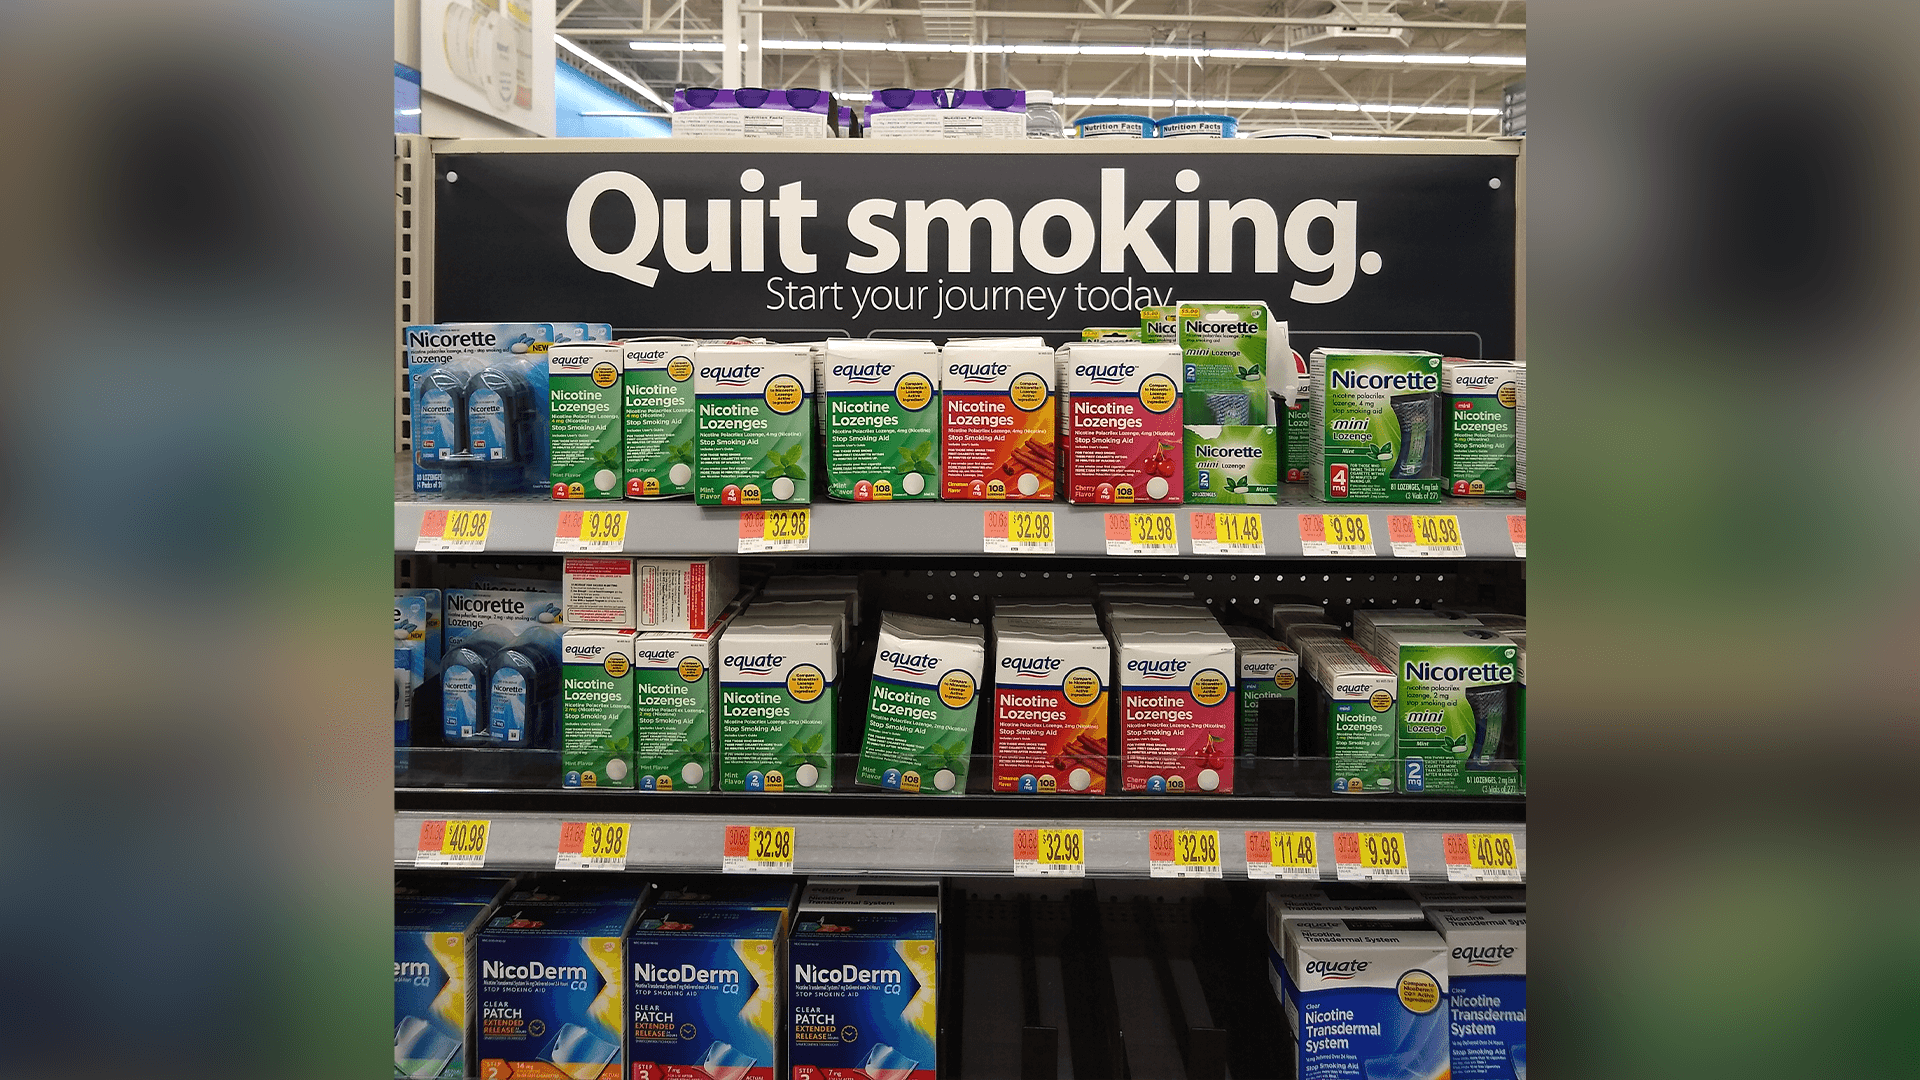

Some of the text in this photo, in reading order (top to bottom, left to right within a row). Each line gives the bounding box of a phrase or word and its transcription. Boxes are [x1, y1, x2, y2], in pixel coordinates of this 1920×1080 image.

[1084, 123, 1141, 133] Nutrition Facts
[1163, 123, 1221, 133] Nutrition Facts
[566, 167, 1383, 304] Quit smoking.
[767, 277, 843, 311] Start
[850, 285, 929, 319] your
[932, 279, 1068, 319] journey
[1187, 321, 1258, 333] Nicorette
[410, 331, 496, 348] Nicorette
[532, 344, 549, 352] NEW
[1186, 348, 1210, 356] mini
[411, 354, 453, 365] Lozenge
[552, 355, 589, 366] equate
[627, 350, 665, 361] equate
[700, 364, 761, 381] equate
[833, 363, 892, 380] equate
[949, 362, 1007, 379] equate
[1075, 363, 1135, 380] equate
[1187, 366, 1194, 376] 2
[1332, 370, 1437, 390] Nicorette
[1456, 375, 1495, 386] equate
[551, 390, 602, 400] Nicotine
[626, 385, 677, 395] Nicotine
[551, 401, 610, 413] Lozenges
[626, 395, 686, 407] Lozenges
[948, 401, 1006, 412] Nicotine
[700, 404, 759, 416] Nicotine
[832, 402, 889, 413] Nicotine
[1075, 402, 1134, 414] Nicotine
[1347, 408, 1371, 416] smoking
[832, 414, 899, 427] Lozenges
[948, 414, 1014, 427] Lozenges
[1454, 411, 1501, 420] Nicotine
[700, 418, 768, 430] Lozenges
[1075, 416, 1143, 428] Lozenges
[1333, 417, 1369, 430] mini
[1454, 422, 1508, 432] Lozenges
[964, 434, 995, 442] Smoking
[1333, 433, 1372, 442] Lozenge
[1196, 445, 1262, 458] Nicorette
[1196, 461, 1219, 469] mini
[1200, 473, 1208, 483] 2
[1332, 468, 1346, 484] 4
[1332, 484, 1346, 493] mg
[451, 513, 487, 537] $40.98
[588, 513, 621, 538] $9.98
[770, 512, 805, 537] $32.98
[1013, 514, 1050, 539] $32.98
[1134, 516, 1172, 540] $32.98
[1220, 516, 1259, 541] $11.48
[1330, 517, 1366, 542] $9.98
[1417, 518, 1457, 543] $40.98
[448, 595, 525, 613] Nicorette
[448, 617, 483, 629] Lozenge
[565, 645, 602, 656] equate
[638, 649, 676, 660] equate
[724, 653, 782, 670] equate
[880, 650, 938, 670] equate
[1001, 656, 1061, 674] equate
[1127, 658, 1187, 676] equate
[1244, 663, 1274, 673] equate
[1406, 661, 1512, 682] Nicorette
[493, 685, 523, 694] Nicorette
[564, 679, 614, 690] Nicotine
[638, 684, 688, 695] Nicotine
[1337, 683, 1370, 694] equate
[564, 690, 622, 702] Lozenges
[638, 695, 696, 707] Lozenges
[723, 692, 781, 704] Nicotine
[874, 686, 931, 705] Nicotine
[1000, 695, 1058, 707] Nicotine
[1126, 696, 1184, 708] Nicotine
[723, 706, 790, 718] Lozenges
[872, 700, 937, 720] Lozenges
[1000, 708, 1067, 721] Lozenges
[1126, 709, 1193, 721] Lozenges
[1408, 709, 1443, 722] mini
[1337, 714, 1377, 722] Nicotine
[1337, 722, 1383, 733] Lozenges
[1407, 724, 1447, 734] Lozenge
[1408, 763, 1421, 778] 2
[766, 775, 781, 783] 108
[1408, 778, 1421, 786] mg
[449, 825, 485, 852] $40.98
[591, 826, 623, 854] $9.98
[754, 831, 789, 858] $32.98
[1042, 833, 1080, 861] $32.98
[1178, 834, 1216, 863] $32.98
[1274, 836, 1313, 866] $11.48
[1365, 836, 1401, 866] $9.98
[1472, 839, 1513, 867] $40.98
[1451, 944, 1515, 963] equate
[483, 961, 587, 980] NicoDerm
[634, 963, 739, 983] NicoDerm
[795, 963, 901, 983] NicoDerm
[1305, 959, 1368, 978] equate
[571, 981, 588, 991] CQ
[722, 984, 739, 994] CQ
[884, 984, 901, 994] CQ
[1451, 994, 1501, 1008] Nicotine
[484, 1009, 522, 1019] PATCH
[635, 1012, 673, 1022] PATCH
[796, 1014, 834, 1024] PATCH
[1305, 1009, 1354, 1024] Nicotine
[1451, 1008, 1526, 1022] Transdermal
[1305, 1023, 1381, 1038] Transdermal
[1451, 1023, 1496, 1038] System
[1305, 1038, 1349, 1053] System
